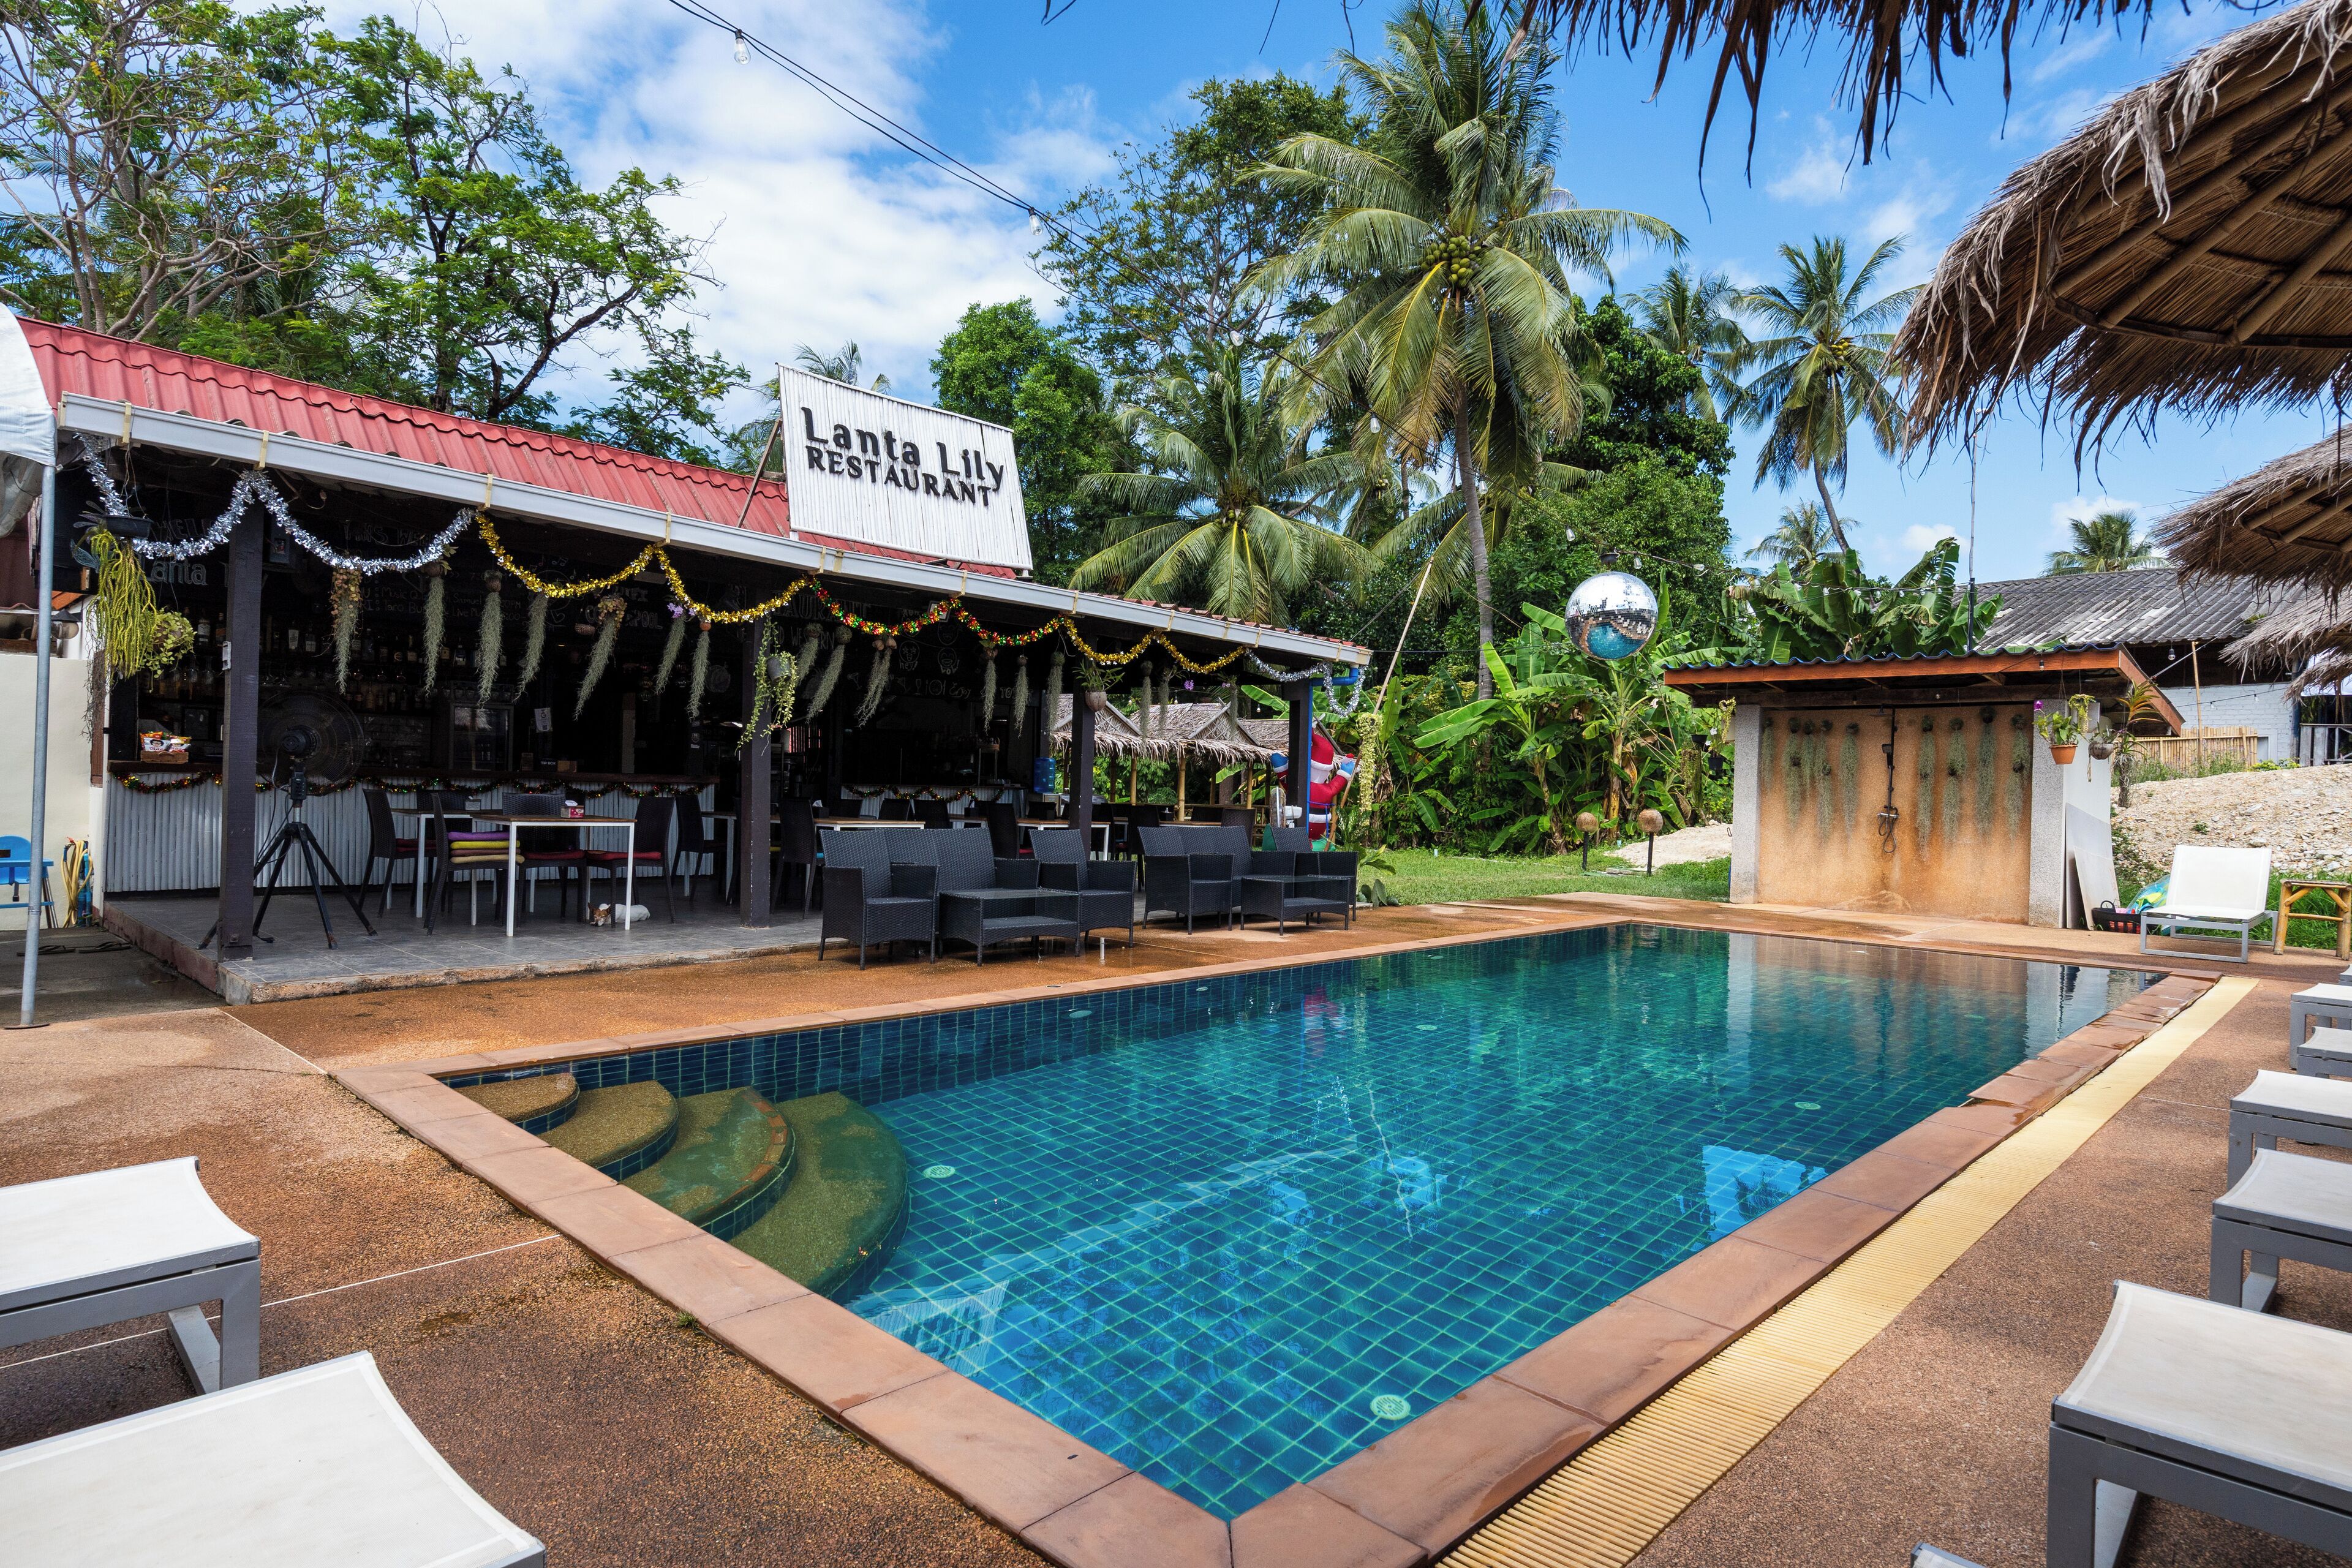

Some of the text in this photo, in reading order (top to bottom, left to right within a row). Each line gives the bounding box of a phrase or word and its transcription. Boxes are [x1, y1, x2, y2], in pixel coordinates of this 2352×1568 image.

[801, 407, 1004, 491] Lanta Lily
[805, 445, 992, 507] RESTAURANT
